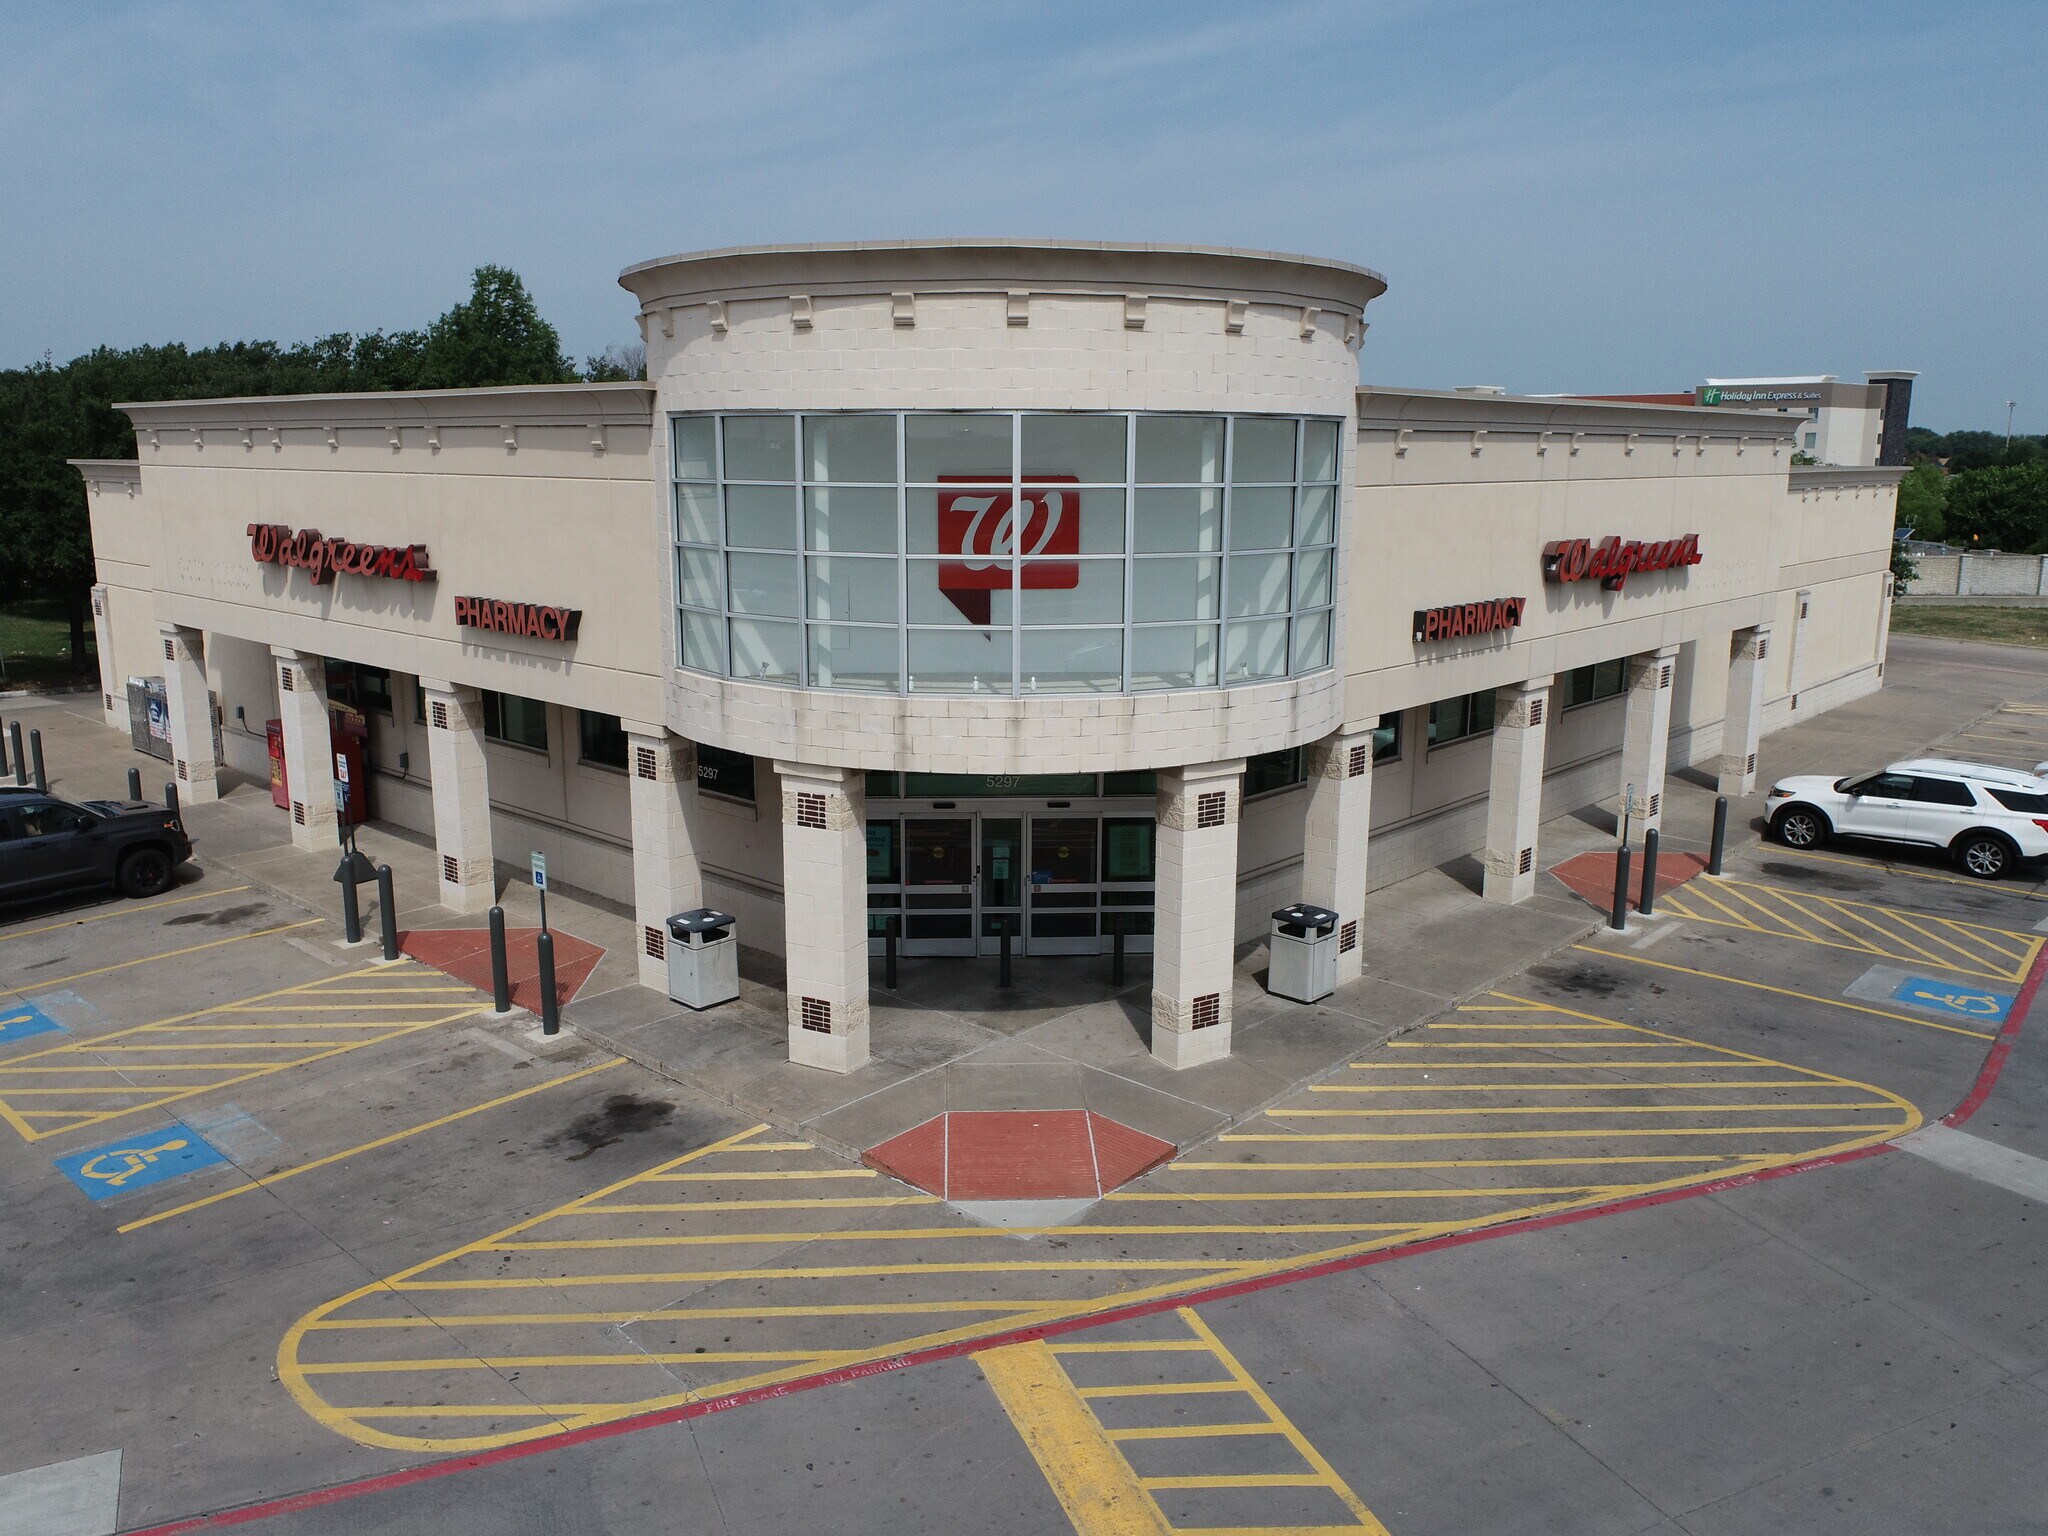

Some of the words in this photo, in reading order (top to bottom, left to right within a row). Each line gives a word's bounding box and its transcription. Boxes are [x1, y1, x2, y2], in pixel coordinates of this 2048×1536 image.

[1720, 391, 1752, 403] Holiday
[1753, 390, 1767, 400] Inn
[1767, 391, 1797, 402] Express
[247, 523, 430, 585] Walgreens
[1549, 534, 1703, 591] Walgreens
[454, 596, 575, 642] PHARMACY
[1422, 597, 1526, 643] PHARMACY
[698, 765, 719, 780] 5297
[986, 775, 1020, 788] 5297
[851, 1358, 912, 1379] PARKING
[704, 1396, 739, 1414] FIRE
